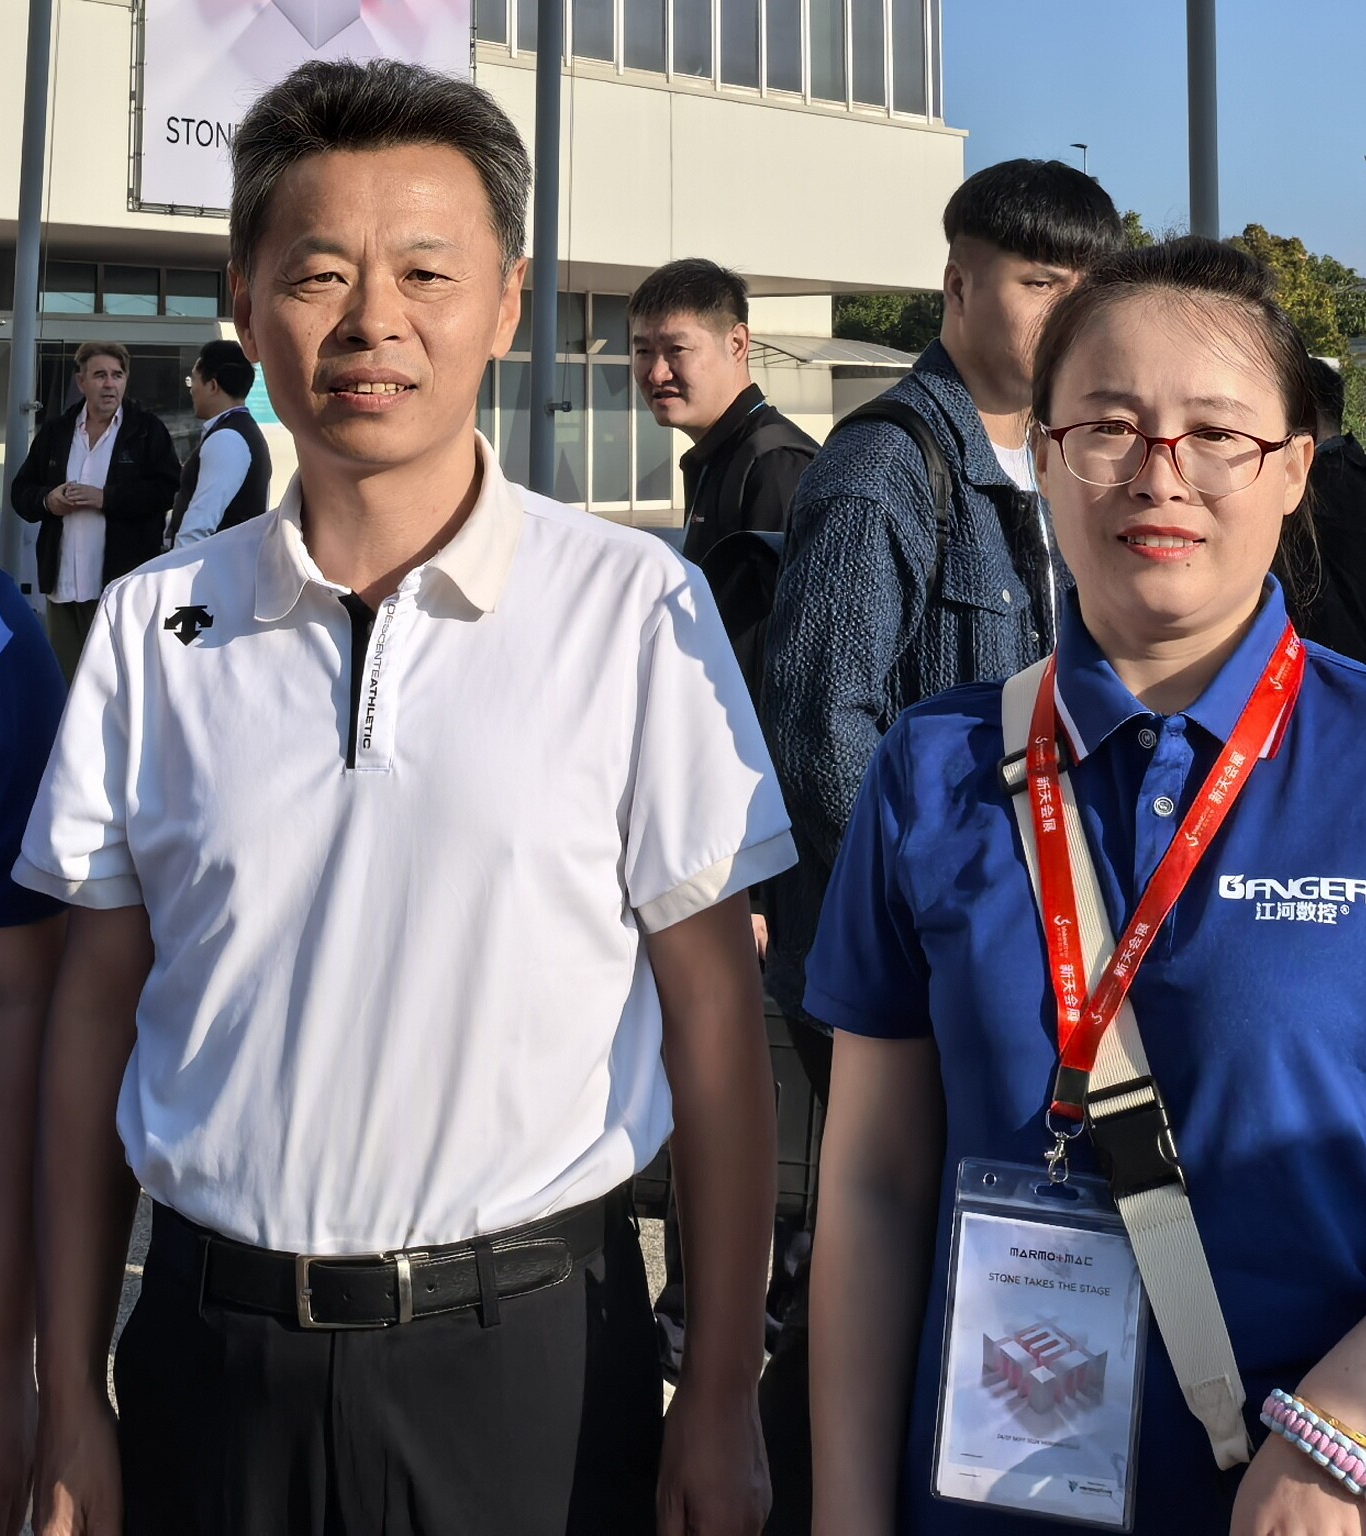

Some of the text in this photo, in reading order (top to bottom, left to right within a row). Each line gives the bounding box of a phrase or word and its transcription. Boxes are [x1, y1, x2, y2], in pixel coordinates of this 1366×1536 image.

[166, 115, 241, 148] STON
[1036, 776, 1056, 833] 新天会展
[1207, 751, 1246, 805] 新天会展
[1113, 922, 1150, 978] 新天会展
[1059, 963, 1081, 1022] 新天会展
[1009, 1247, 1093, 1266] MARMO+MAC
[989, 1272, 1110, 1297] STONE TAKES THE STAGE
